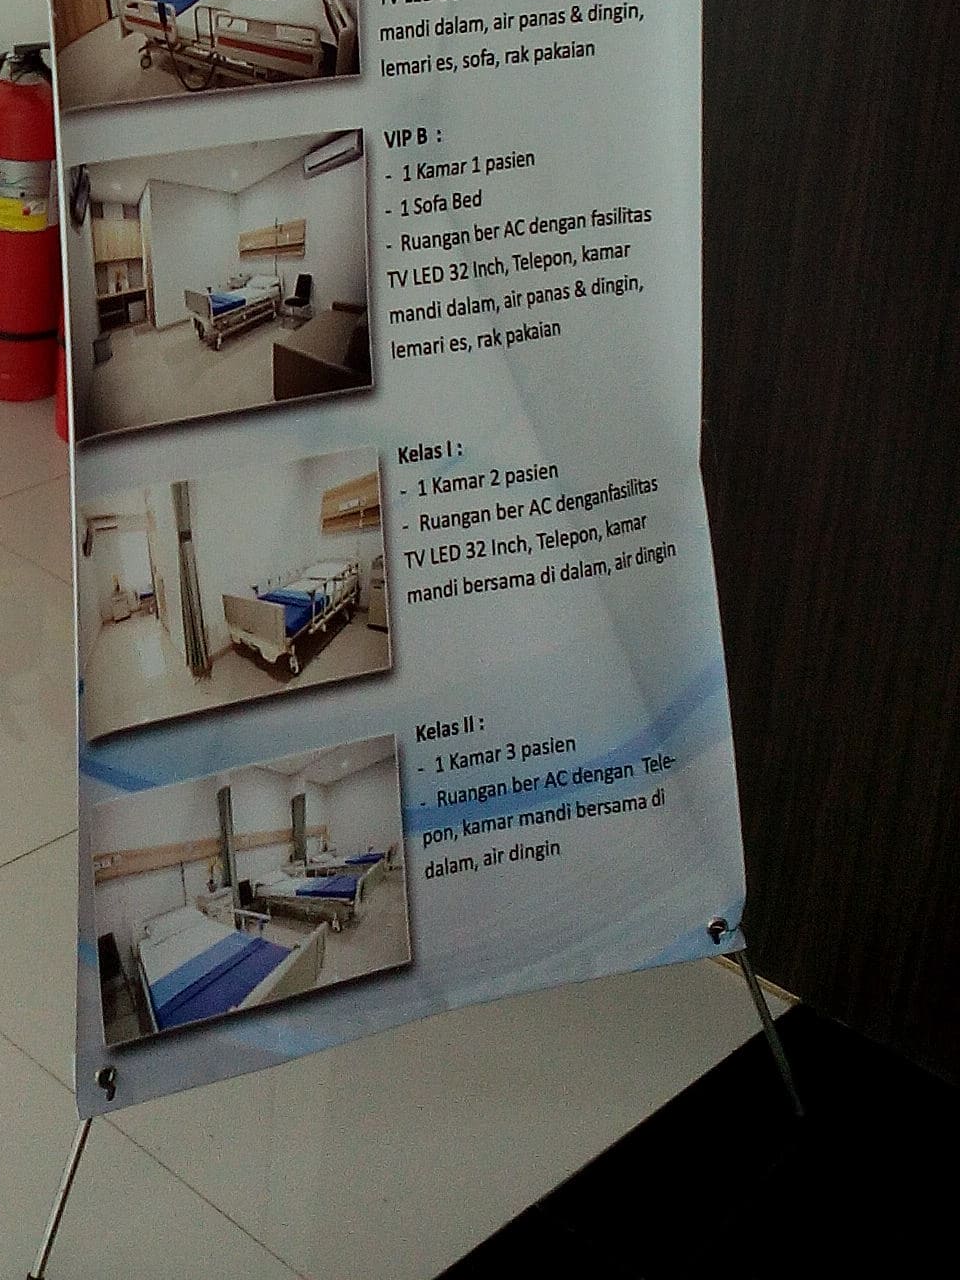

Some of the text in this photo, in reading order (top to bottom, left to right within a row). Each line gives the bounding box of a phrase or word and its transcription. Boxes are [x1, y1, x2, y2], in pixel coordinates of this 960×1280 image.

[380, 2, 644, 42] mandi dalam, air panas dingin,
[380, 41, 596, 77] lemari es, sofa, rak pakaian
[384, 128, 428, 148] VIP B
[416, 151, 535, 180] Kamar pasien
[414, 190, 482, 215] Sofa Bed
[401, 206, 652, 252] Ruangan ber AC dengan fasilitas
[387, 244, 630, 288] TV LED 32 Inch, Telepon, kamar
[390, 275, 644, 324] mandi dalam, air panas dingin,
[391, 320, 561, 360] lemari es, rak pakaian
[398, 441, 452, 464] Kelas I
[432, 463, 558, 495] Kamar 2 pasien
[420, 507, 490, 532] Ruangan
[496, 503, 524, 520] ber
[529, 498, 552, 516] AC
[404, 514, 648, 570] TV LED 32 Inch, Telepon, kamar
[407, 542, 676, 604] mandi bersama di dalam, air dingin
[416, 716, 474, 742] Kelas II
[450, 737, 576, 770] Kamar 3 pasien
[438, 754, 676, 808] Ruangan ber AC dengan Tele-
[423, 788, 666, 849] pon, kamar mandi bersama di
[425, 840, 560, 880] dalam, air dingin
